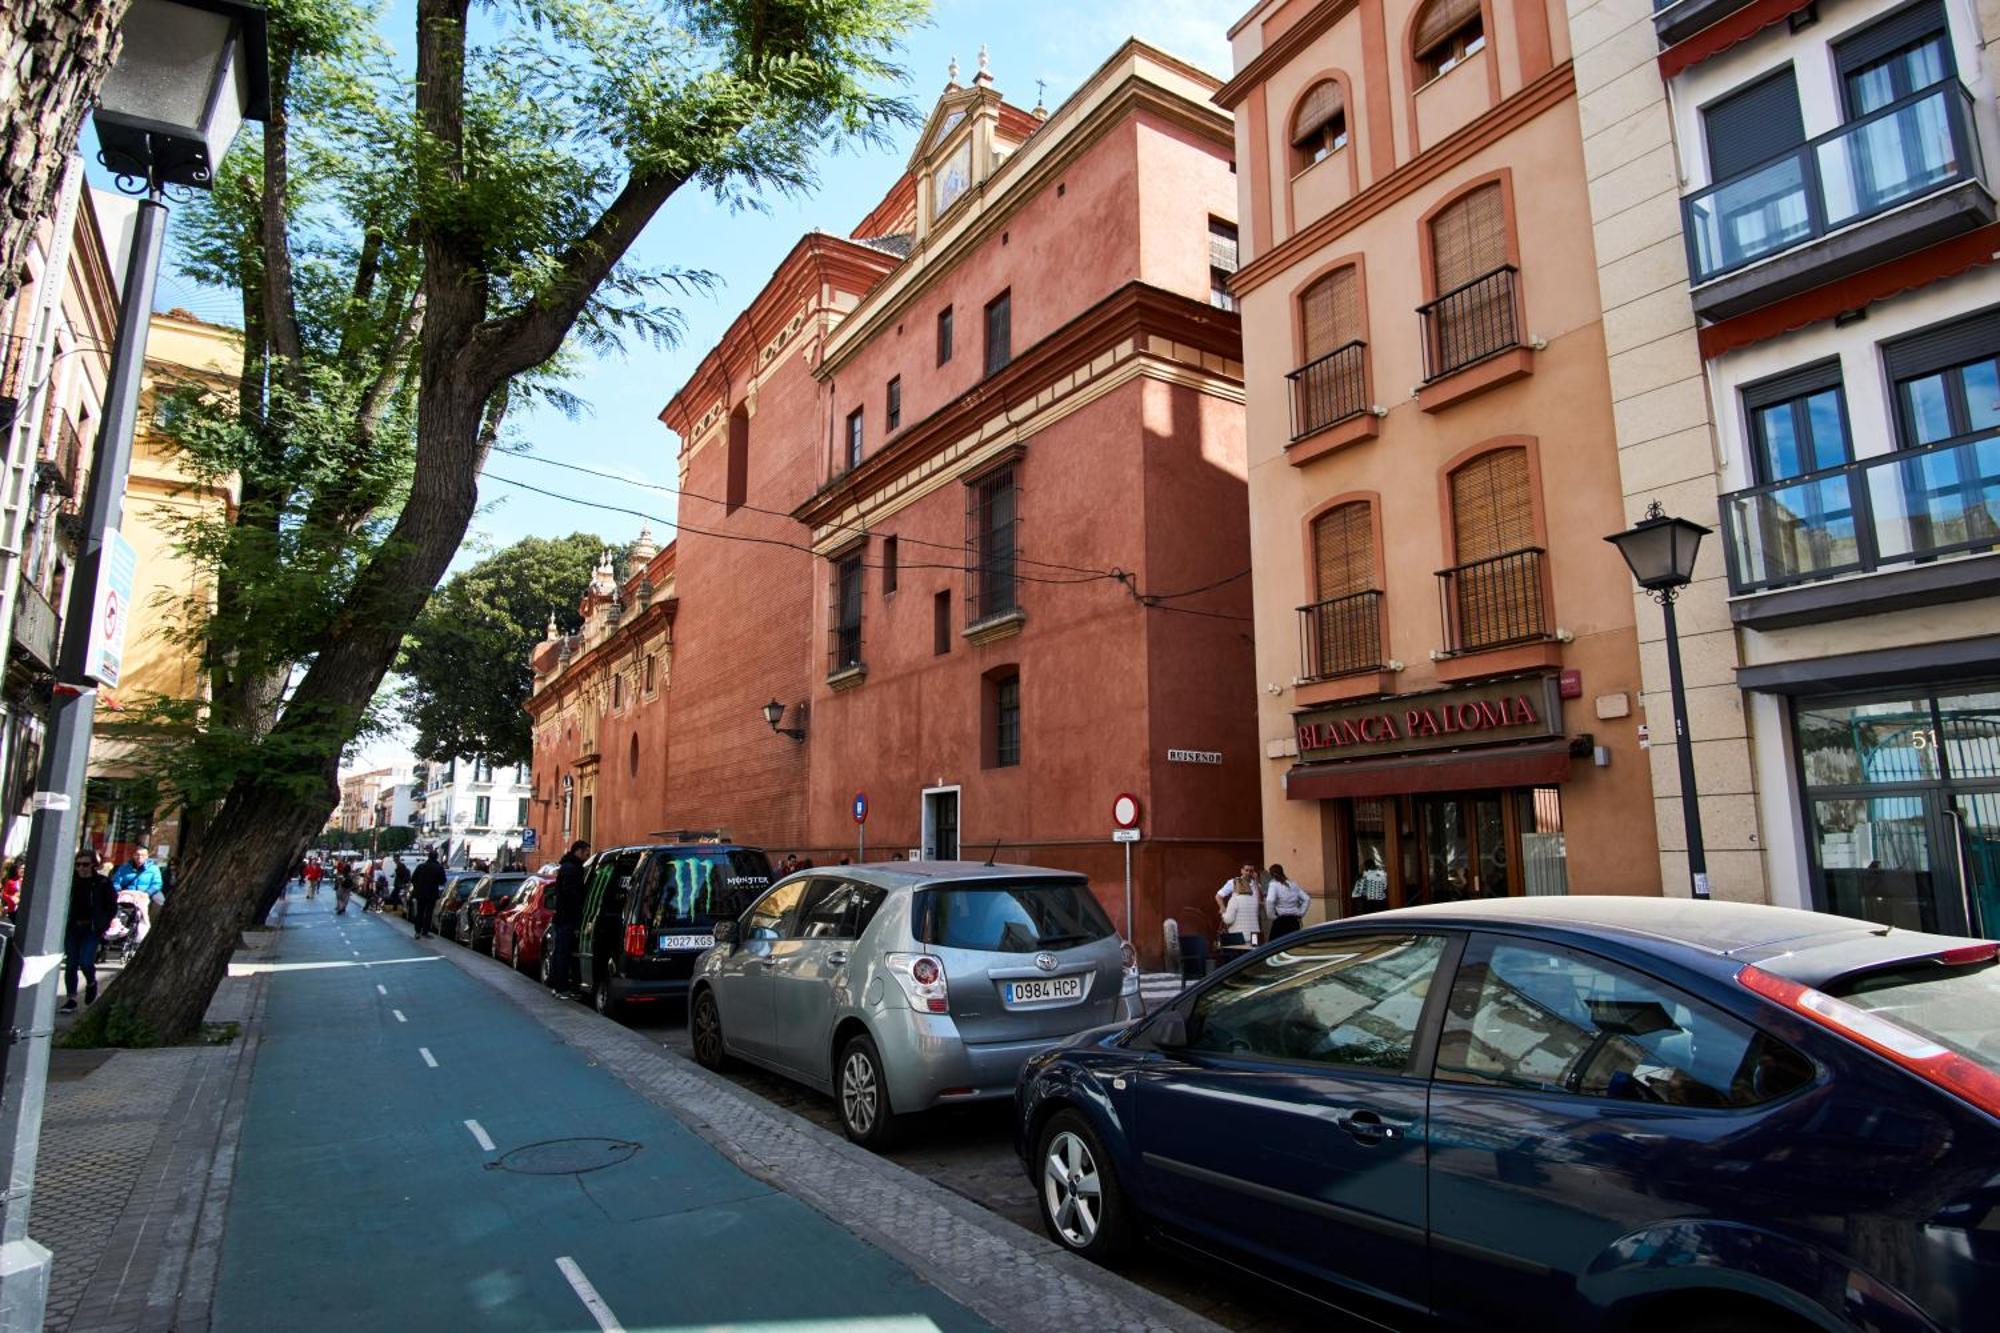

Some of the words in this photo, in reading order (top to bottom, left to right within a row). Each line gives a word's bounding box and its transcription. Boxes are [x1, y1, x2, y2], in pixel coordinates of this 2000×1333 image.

[1298, 713, 1398, 750] BLANCA
[1406, 694, 1537, 737] PALOMA
[1912, 730, 1938, 749] 51
[524, 829, 533, 841] P
[667, 936, 690, 947] 2027
[694, 935, 714, 947] KGS
[1015, 982, 1049, 999] 0984
[1053, 979, 1077, 996] HCP
